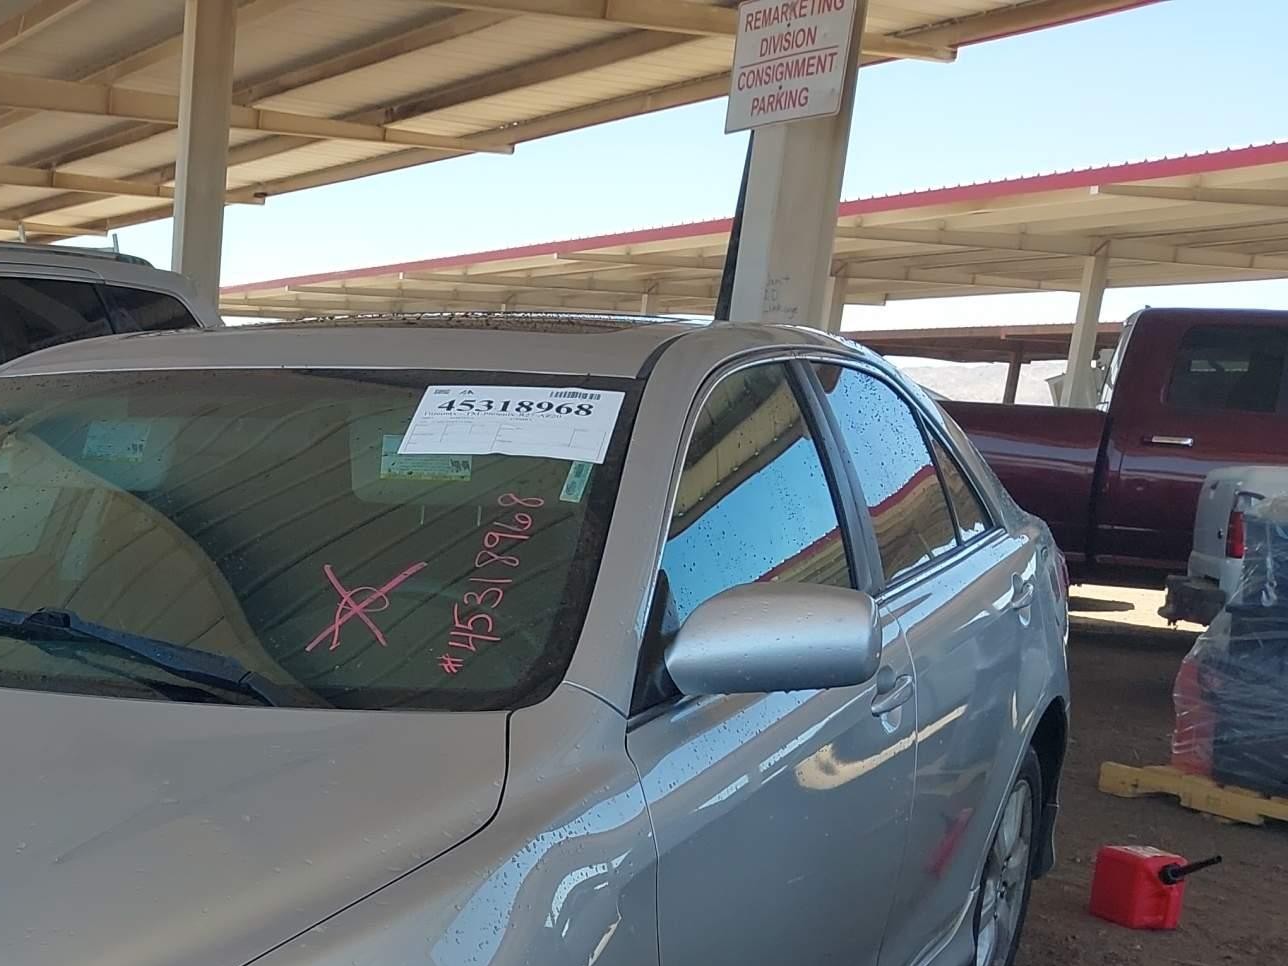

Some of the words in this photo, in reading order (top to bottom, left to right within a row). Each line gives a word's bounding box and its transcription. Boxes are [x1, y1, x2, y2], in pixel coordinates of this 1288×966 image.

[745, 0, 844, 32] REMARKETING
[759, 26, 817, 58] DIVISION
[737, 52, 838, 92] CONSIGNMENT
[750, 87, 809, 117] PARKING
[437, 399, 594, 417] 45318968
